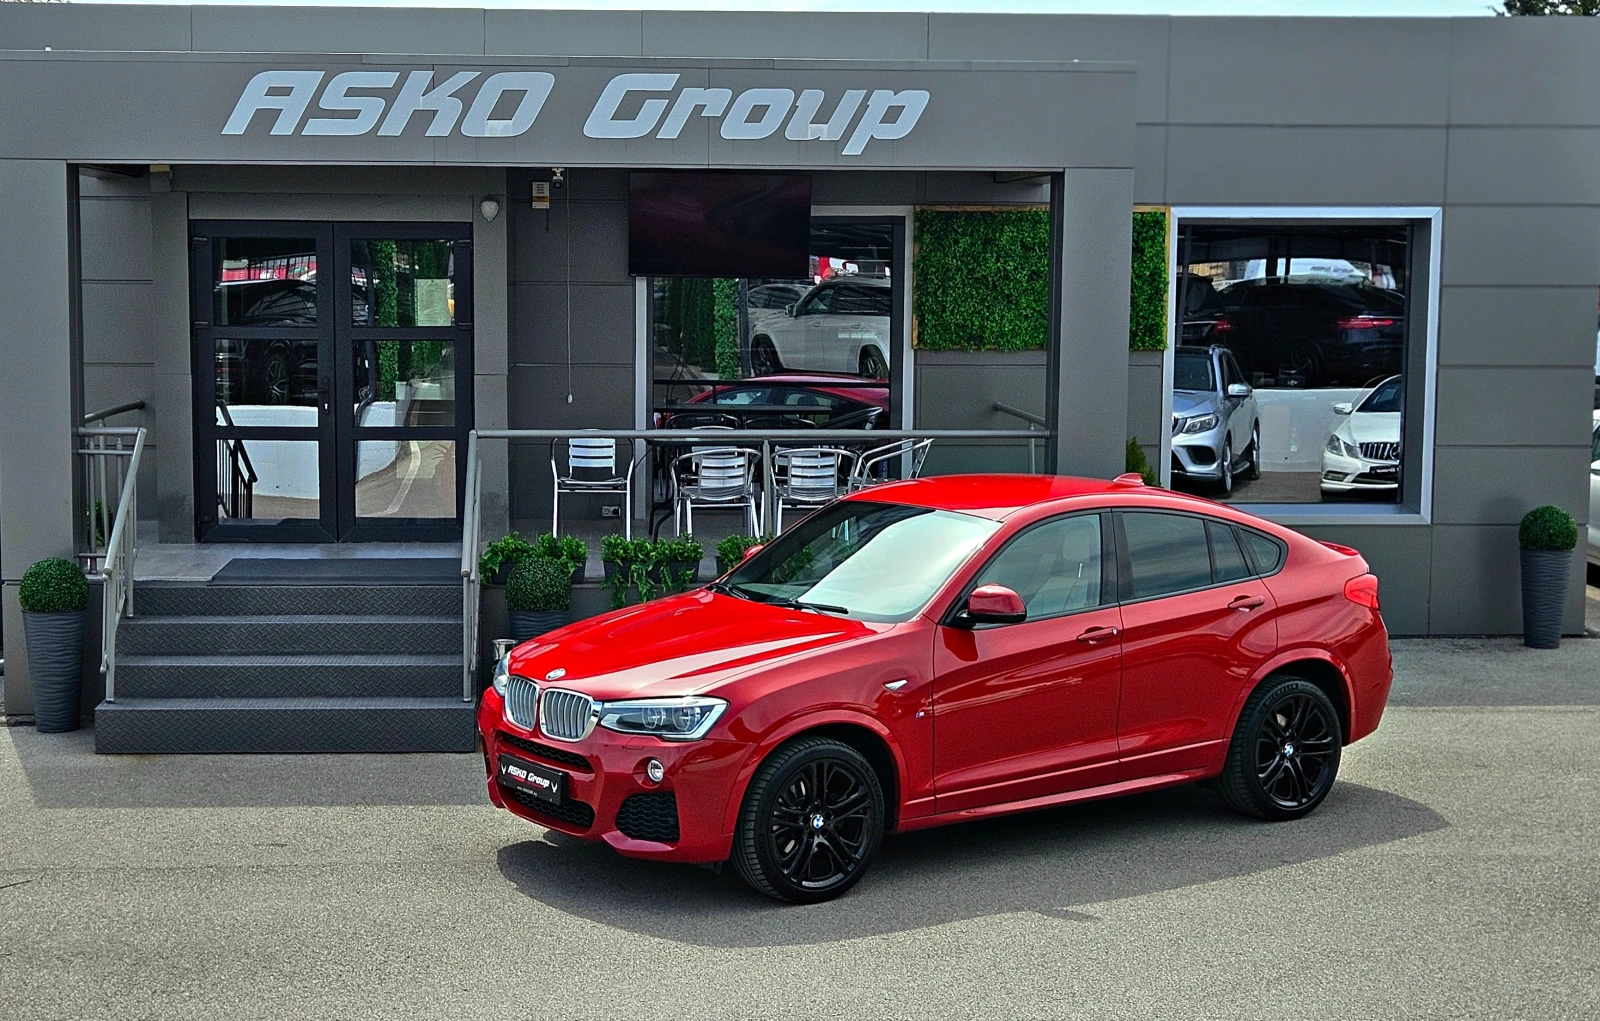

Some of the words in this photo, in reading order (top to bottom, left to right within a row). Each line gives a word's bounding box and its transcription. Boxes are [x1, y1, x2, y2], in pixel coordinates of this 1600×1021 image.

[220, 70, 556, 138] ASKO
[582, 73, 931, 156] Group
[507, 765, 527, 779] ASKO
[527, 772, 550, 788] Group
